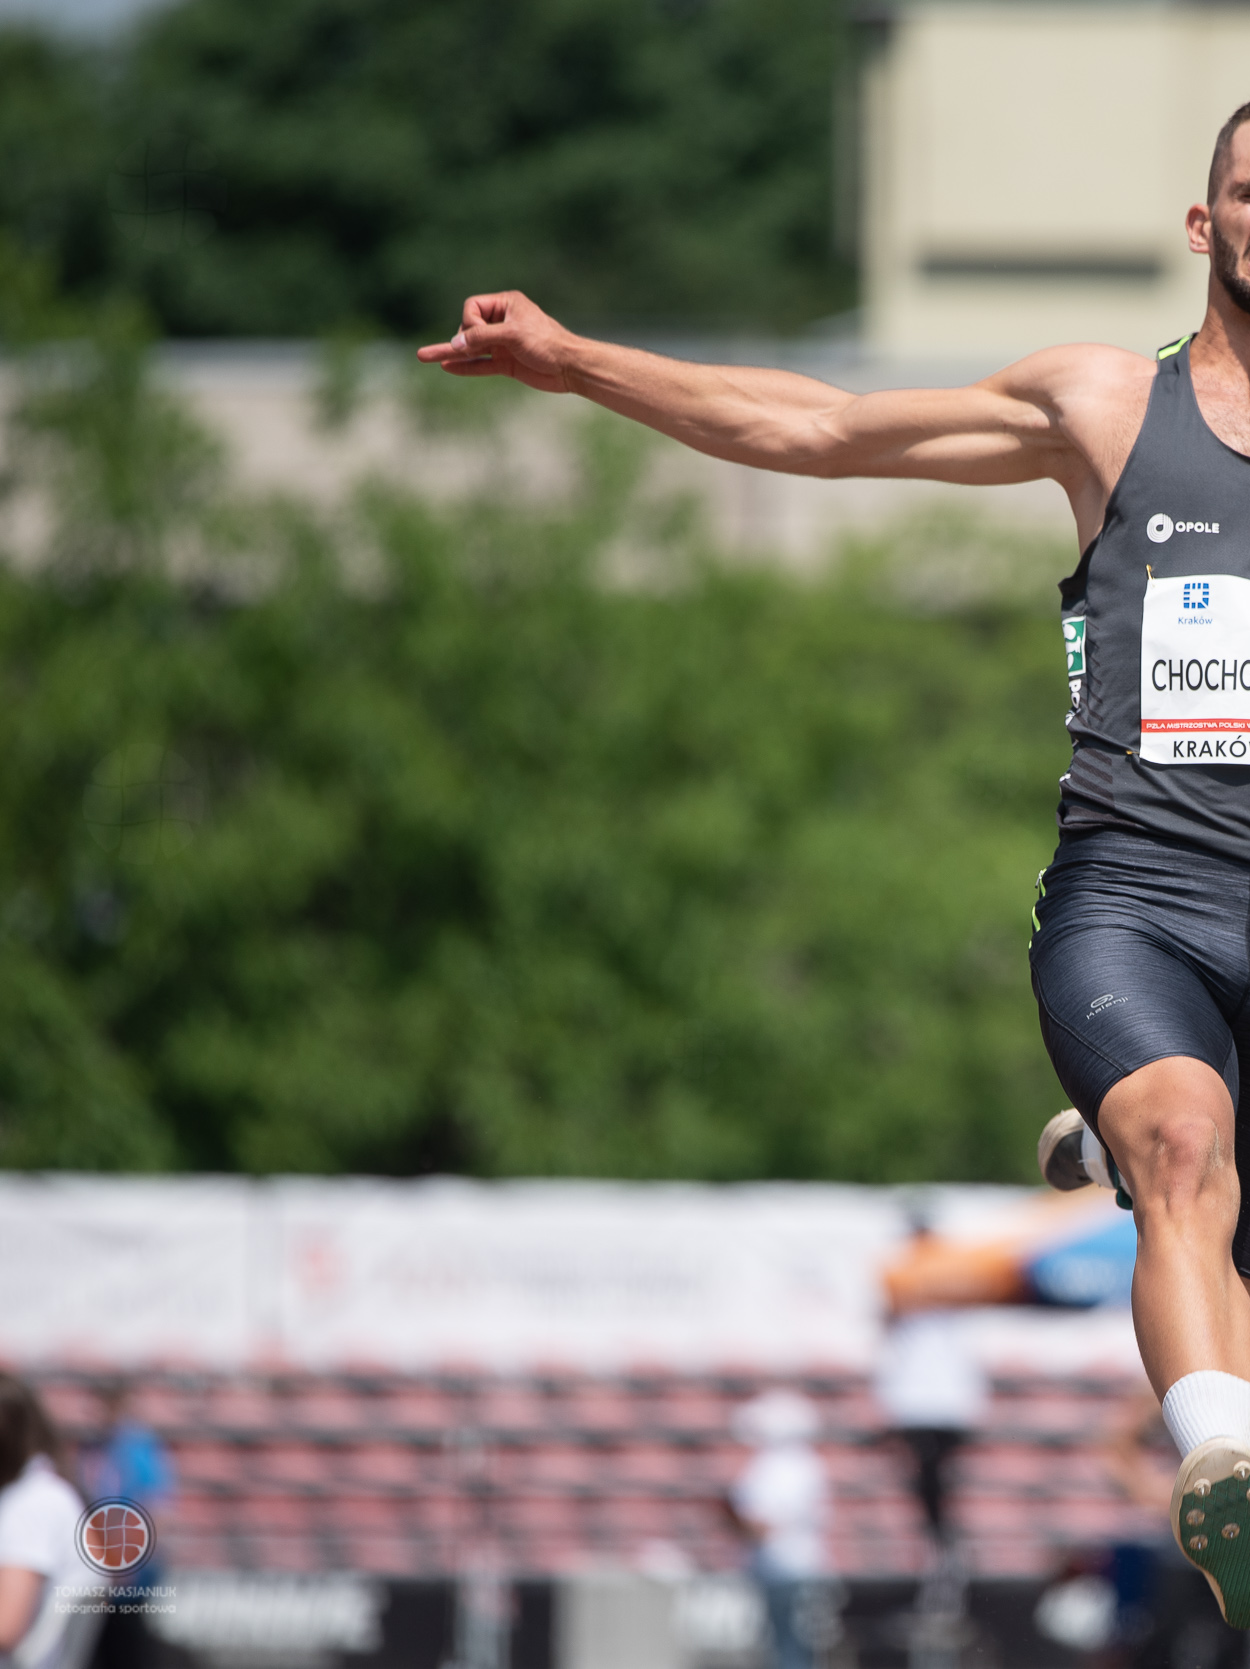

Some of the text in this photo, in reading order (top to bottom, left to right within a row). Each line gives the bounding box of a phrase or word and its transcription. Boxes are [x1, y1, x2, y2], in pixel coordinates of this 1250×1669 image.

[1175, 521, 1220, 534] OPOLE
[1178, 616, 1213, 625] Kraków
[1167, 722, 1218, 730] MISTRZOSTWA
